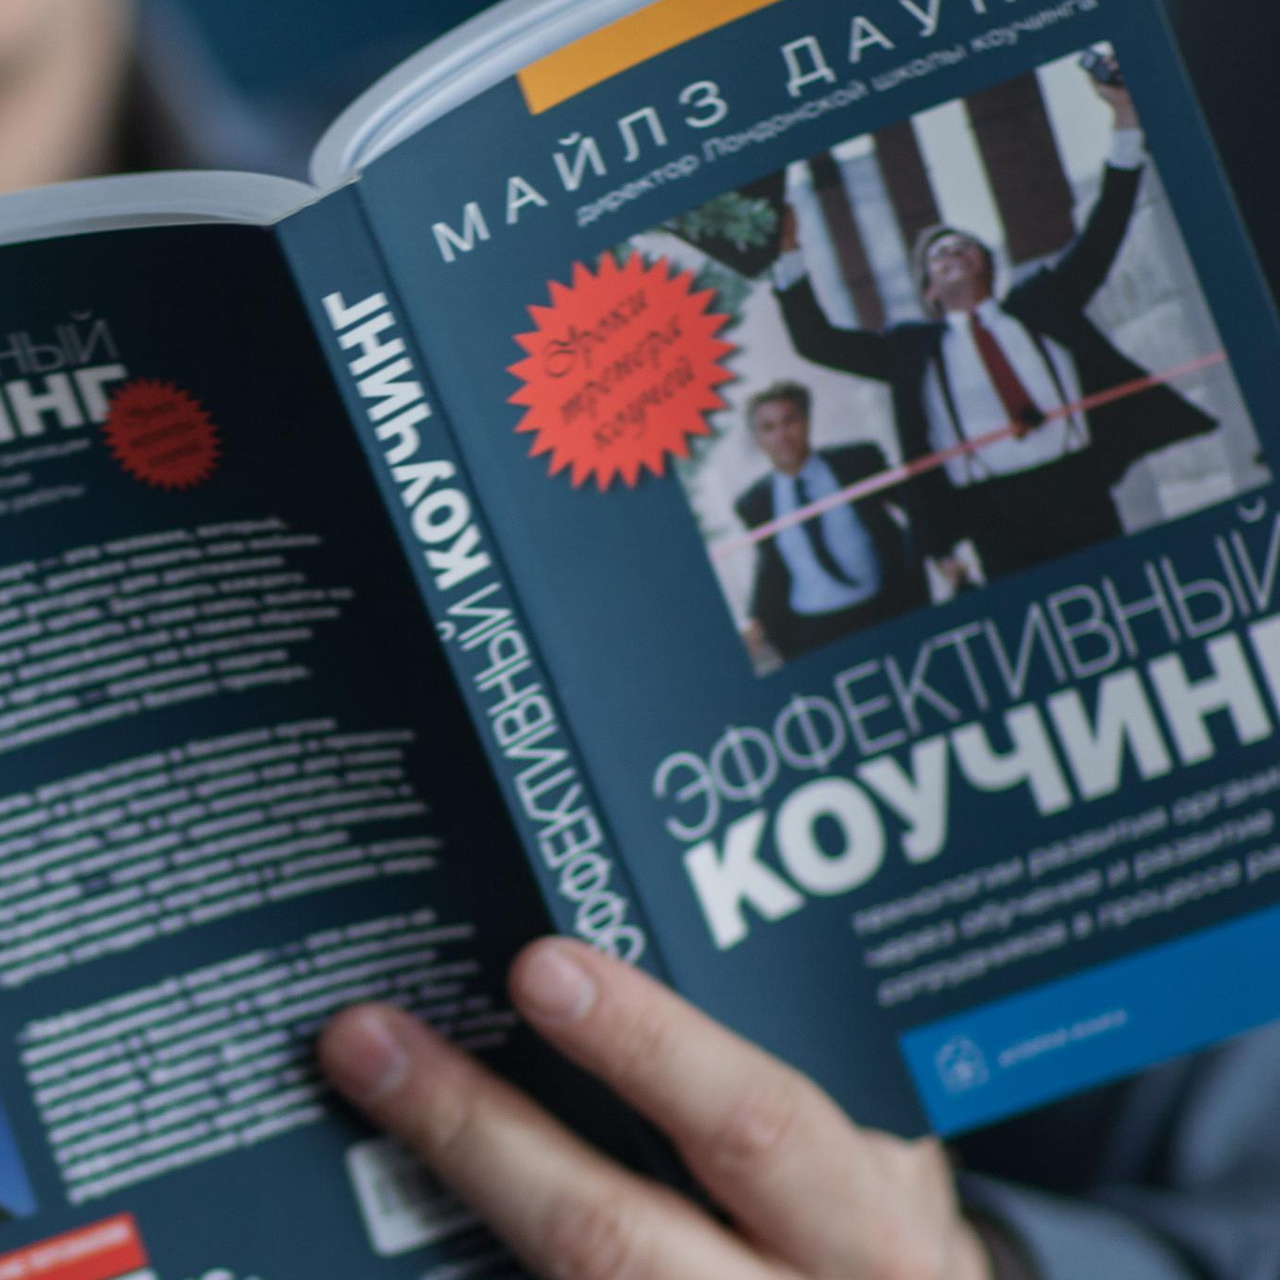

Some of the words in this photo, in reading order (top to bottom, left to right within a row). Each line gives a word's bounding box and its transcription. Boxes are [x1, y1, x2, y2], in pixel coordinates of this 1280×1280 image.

[432, 81, 728, 263] МАЙЛЗ
[576, 153, 701, 227] директор
[702, 79, 868, 164] Лондонской
[871, 45, 967, 93] школы
[322, 292, 491, 591] КОУЧИНГ
[652, 498, 1280, 841] ЭФФЕКТИВНЫЙ
